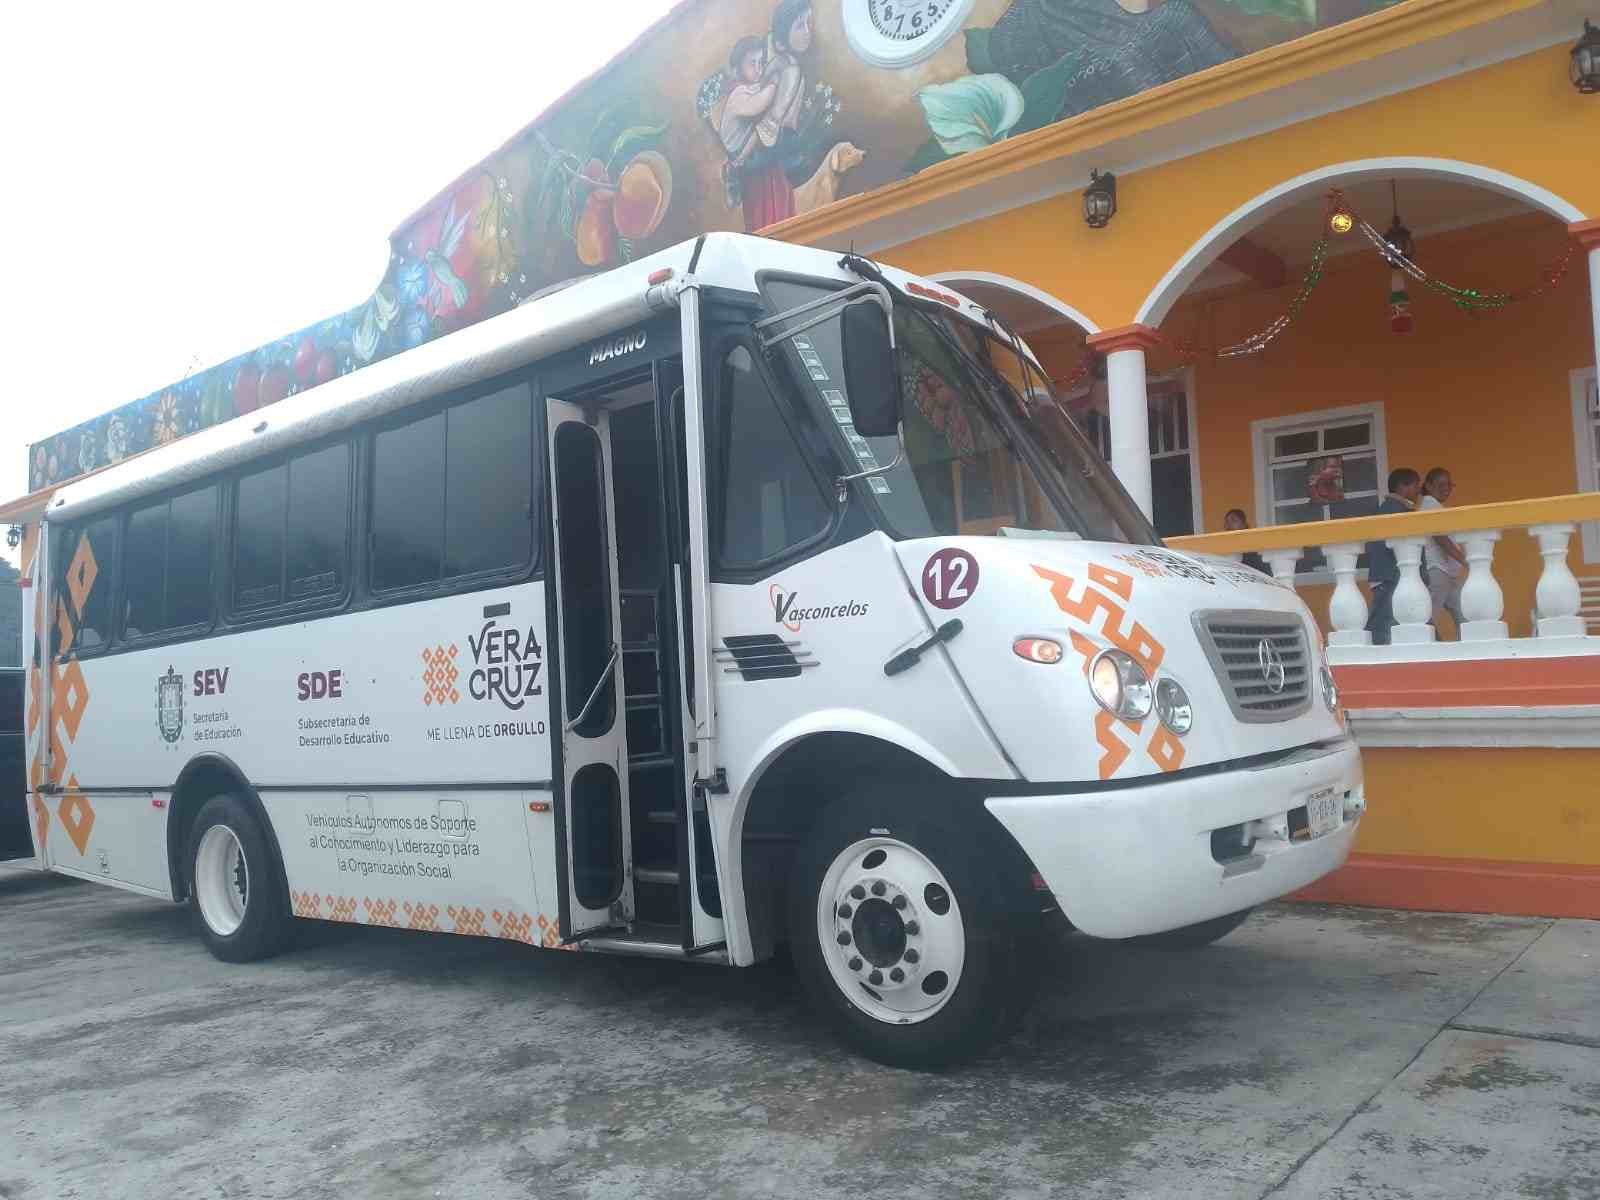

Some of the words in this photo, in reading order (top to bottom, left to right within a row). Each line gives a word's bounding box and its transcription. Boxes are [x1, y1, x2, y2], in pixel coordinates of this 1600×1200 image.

[894, 14, 905, 33] 7
[911, 11, 922, 28] 6
[589, 330, 647, 365] MAGNO
[929, 556, 969, 601] 12
[775, 591, 869, 623] Vasconcelos
[468, 620, 542, 665] VERA
[193, 667, 230, 697] SEV
[298, 669, 342, 701] SDE
[468, 662, 542, 710] CRUZ
[358, 713, 370, 726] de
[426, 727, 441, 741] ME
[443, 725, 475, 740] LLENA
[478, 724, 491, 738] DE
[494, 720, 545, 737] ORGULLO
[194, 728, 203, 741] de
[299, 733, 341, 747] Desarrollo
[344, 730, 390, 745] Educativo
[414, 815, 428, 831] de
[430, 815, 477, 832] Soporte
[309, 836, 318, 849] al
[319, 835, 386, 852] Conocimiento
[395, 838, 450, 858] Liderazgo
[453, 844, 480, 857] para
[416, 862, 452, 879] Social
